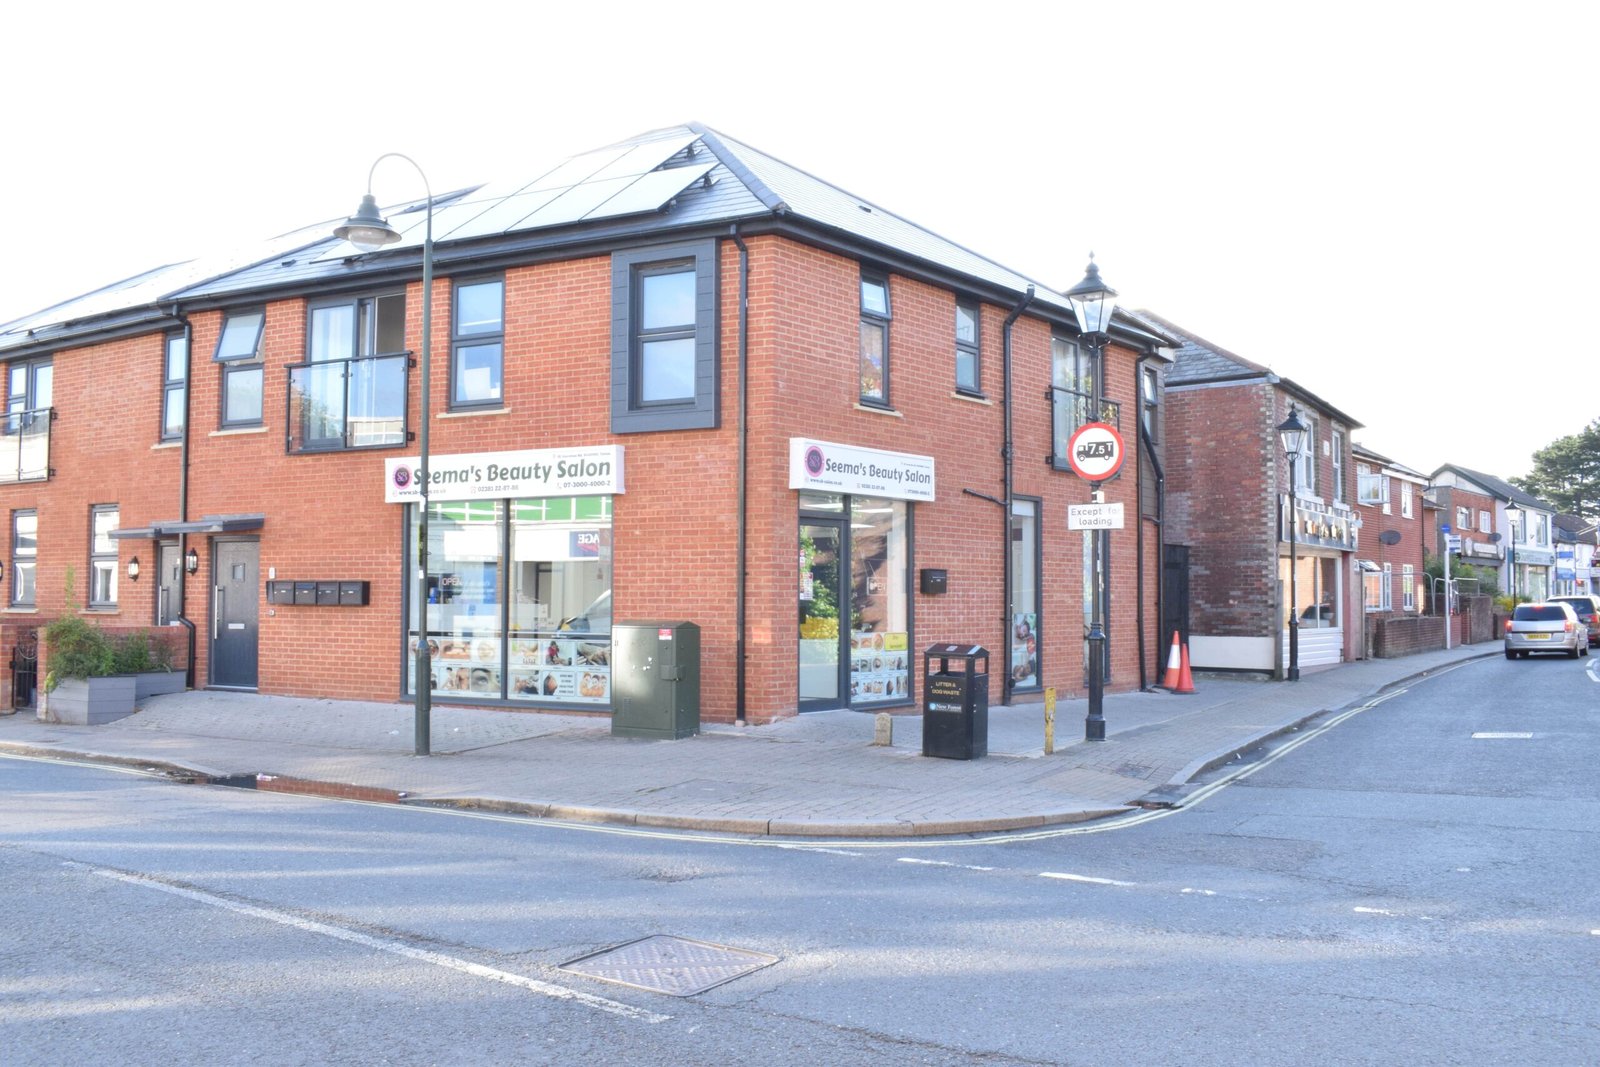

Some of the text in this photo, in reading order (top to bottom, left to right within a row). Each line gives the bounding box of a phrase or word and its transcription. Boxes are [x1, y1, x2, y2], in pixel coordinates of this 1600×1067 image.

[486, 462, 552, 483] Beauty
[557, 458, 611, 479] Salon
[825, 458, 931, 484] Seema's Beauty Salon
[1071, 507, 1103, 516] Except
[1079, 517, 1113, 527] loading
